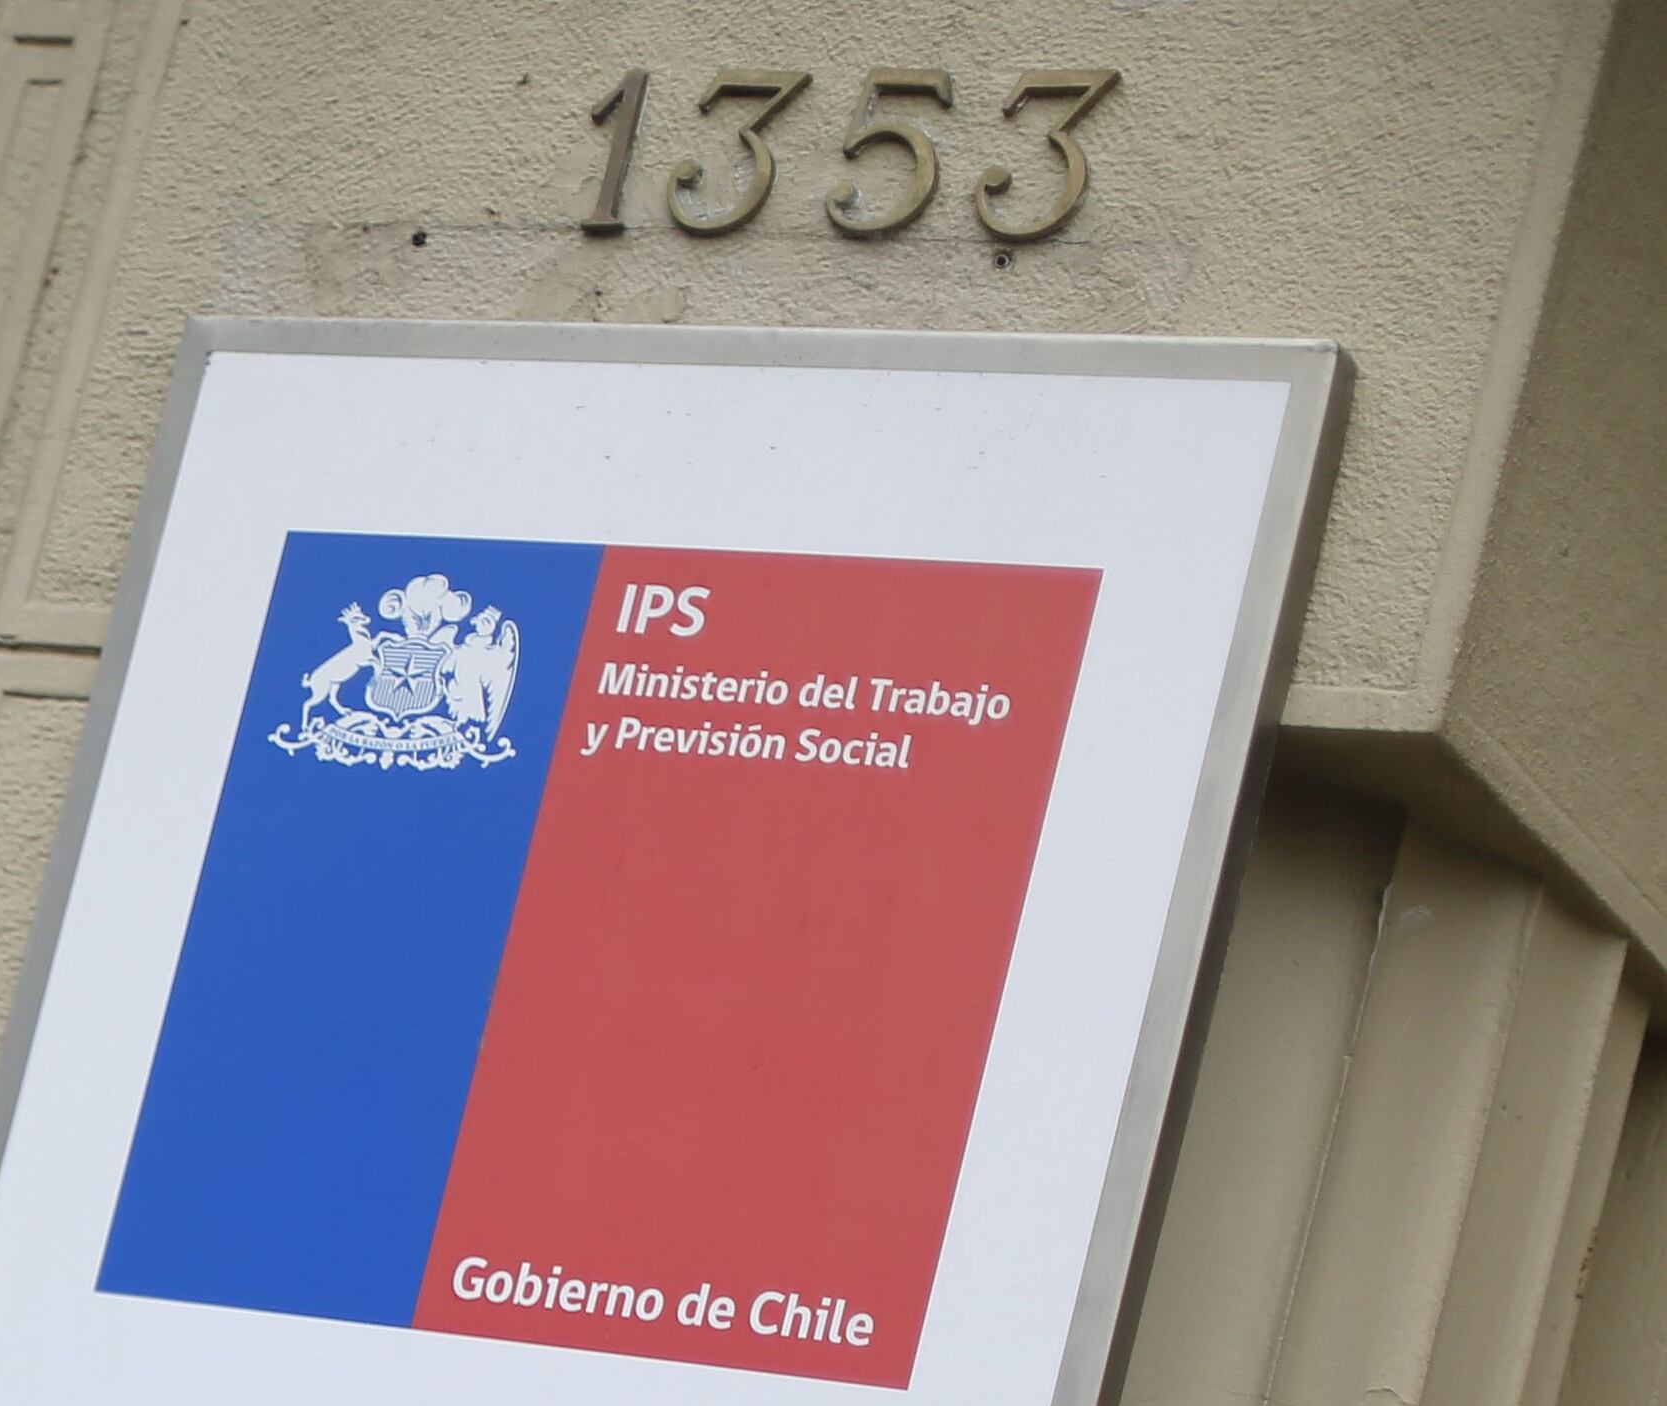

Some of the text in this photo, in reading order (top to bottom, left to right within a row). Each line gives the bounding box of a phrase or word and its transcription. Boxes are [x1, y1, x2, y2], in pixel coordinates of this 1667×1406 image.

[581, 68, 1122, 238] 1353
[616, 583, 711, 638] IPS
[597, 662, 1011, 725] Ministerio del Trabajo
[580, 715, 912, 769] y Previsión Social
[451, 1255, 875, 1346] Gobierno de Chile
